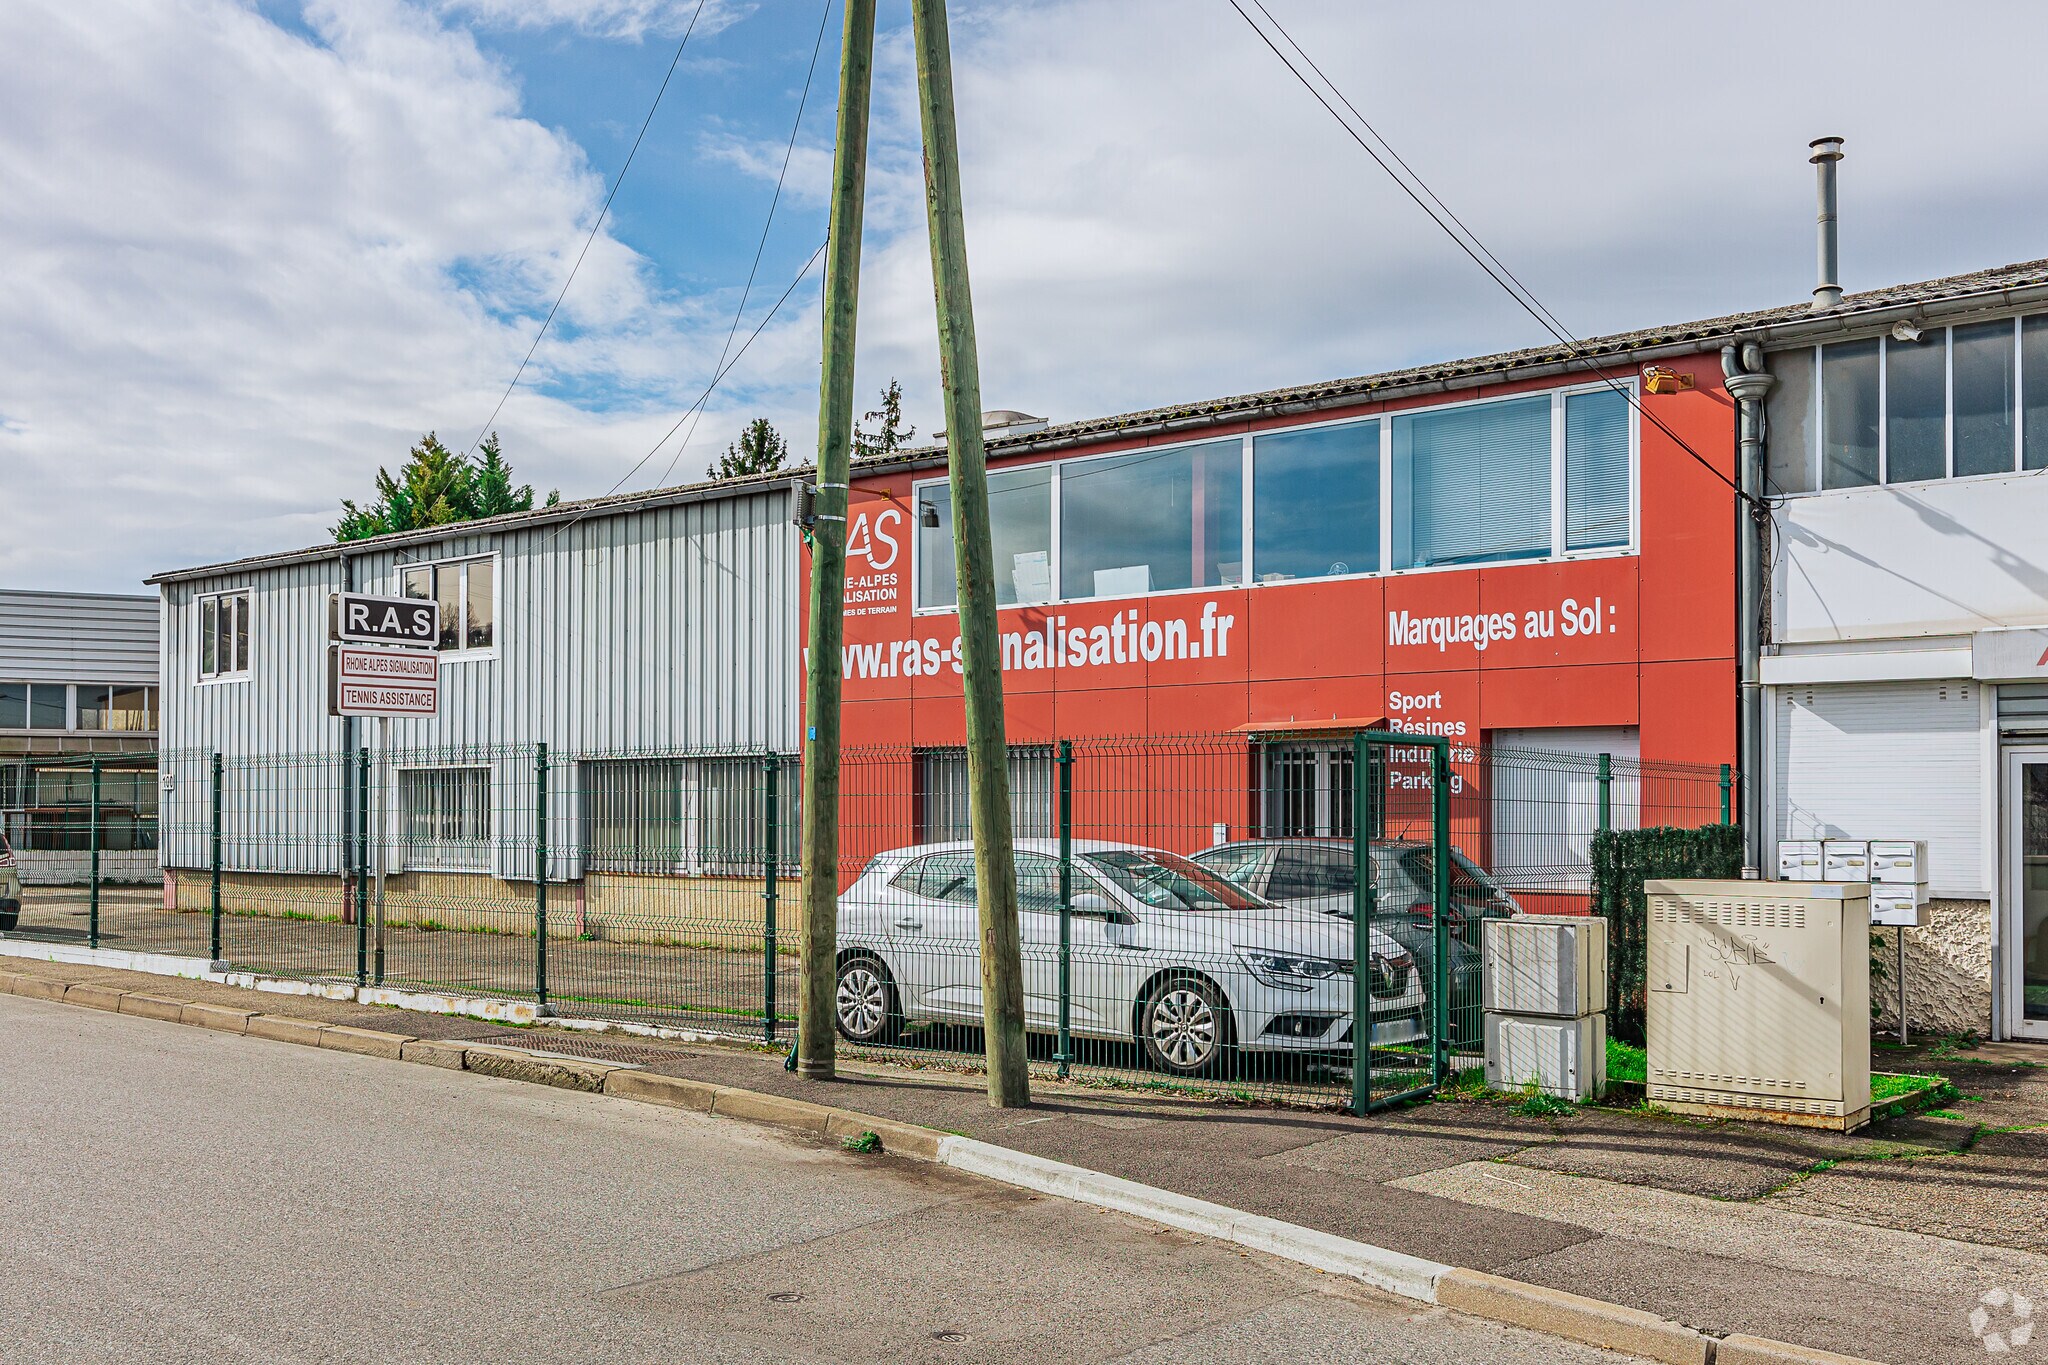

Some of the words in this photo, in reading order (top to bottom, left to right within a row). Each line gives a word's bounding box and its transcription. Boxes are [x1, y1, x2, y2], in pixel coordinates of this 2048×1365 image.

[349, 603, 431, 636] R.A.S
[868, 606, 897, 614] TERRAIN
[1389, 610, 1516, 652] Marquages
[1524, 610, 1555, 639] au
[1560, 597, 1602, 637] Sol
[346, 657, 368, 671] RHONE
[368, 658, 388, 672] ALPES
[389, 660, 433, 675] SIGNALISATION
[346, 690, 378, 704] TENNIS
[379, 691, 432, 707] ASSISTANCE
[1388, 691, 1442, 714] Sport
[1389, 716, 1467, 736] Résines
[1389, 741, 1475, 763] Indurie
[1390, 771, 1463, 794] Parkg
